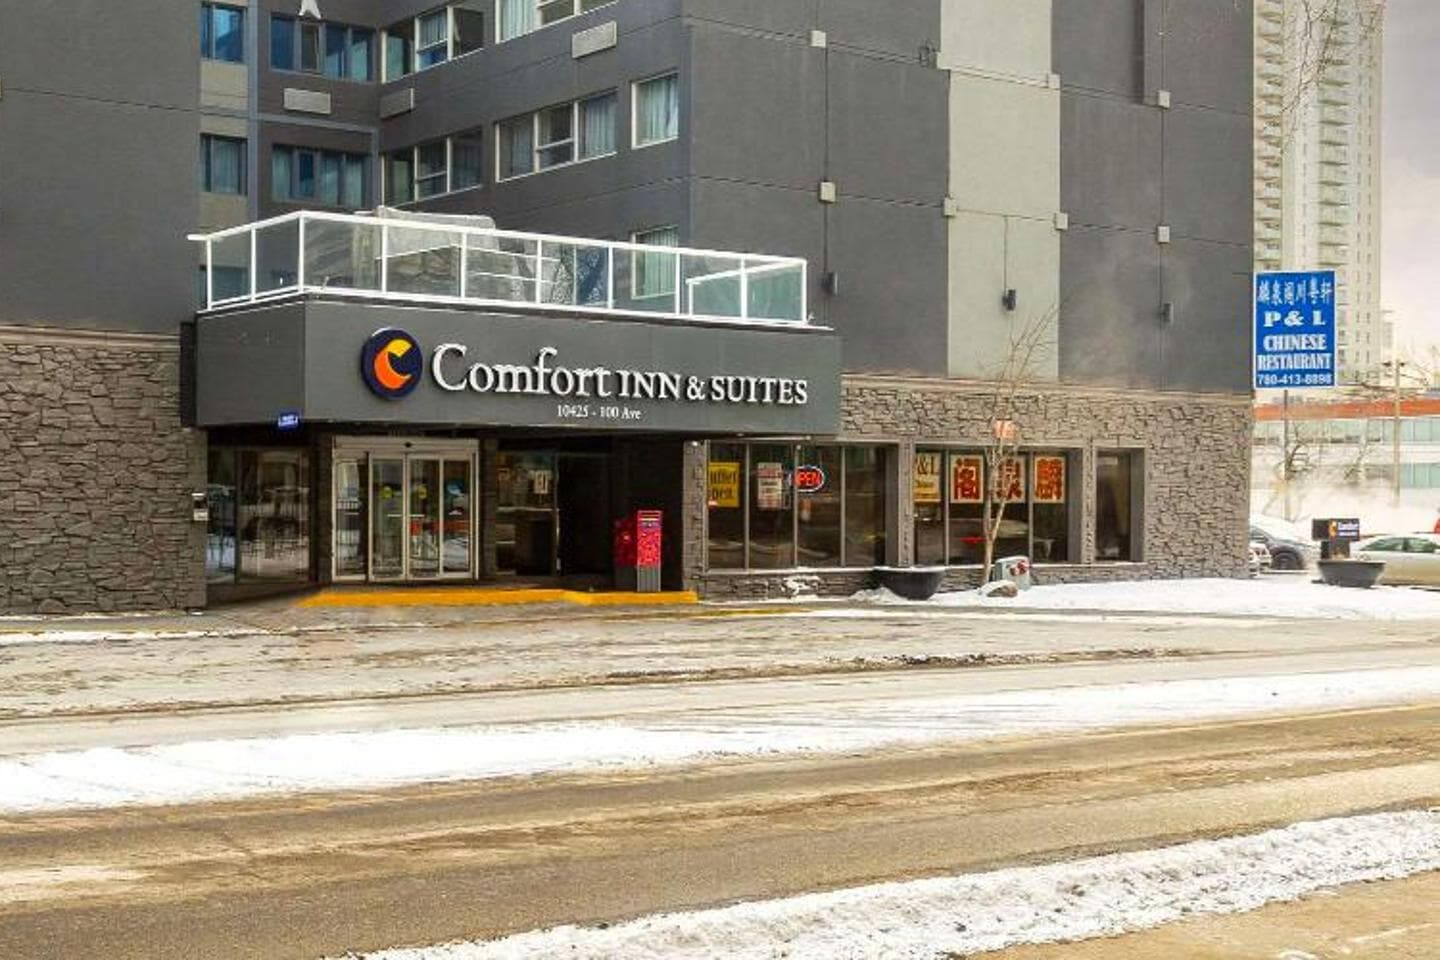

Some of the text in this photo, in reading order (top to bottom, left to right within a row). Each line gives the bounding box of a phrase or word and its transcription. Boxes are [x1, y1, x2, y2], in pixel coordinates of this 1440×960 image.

[1263, 310, 1326, 328] P & L
[1263, 333, 1328, 352] CHINESE
[1257, 353, 1333, 370] RESTAURANT
[432, 343, 808, 404] Comfort INN & SUITES
[557, 404, 588, 418] 10425
[600, 406, 619, 418] 100
[621, 407, 641, 420] Ave
